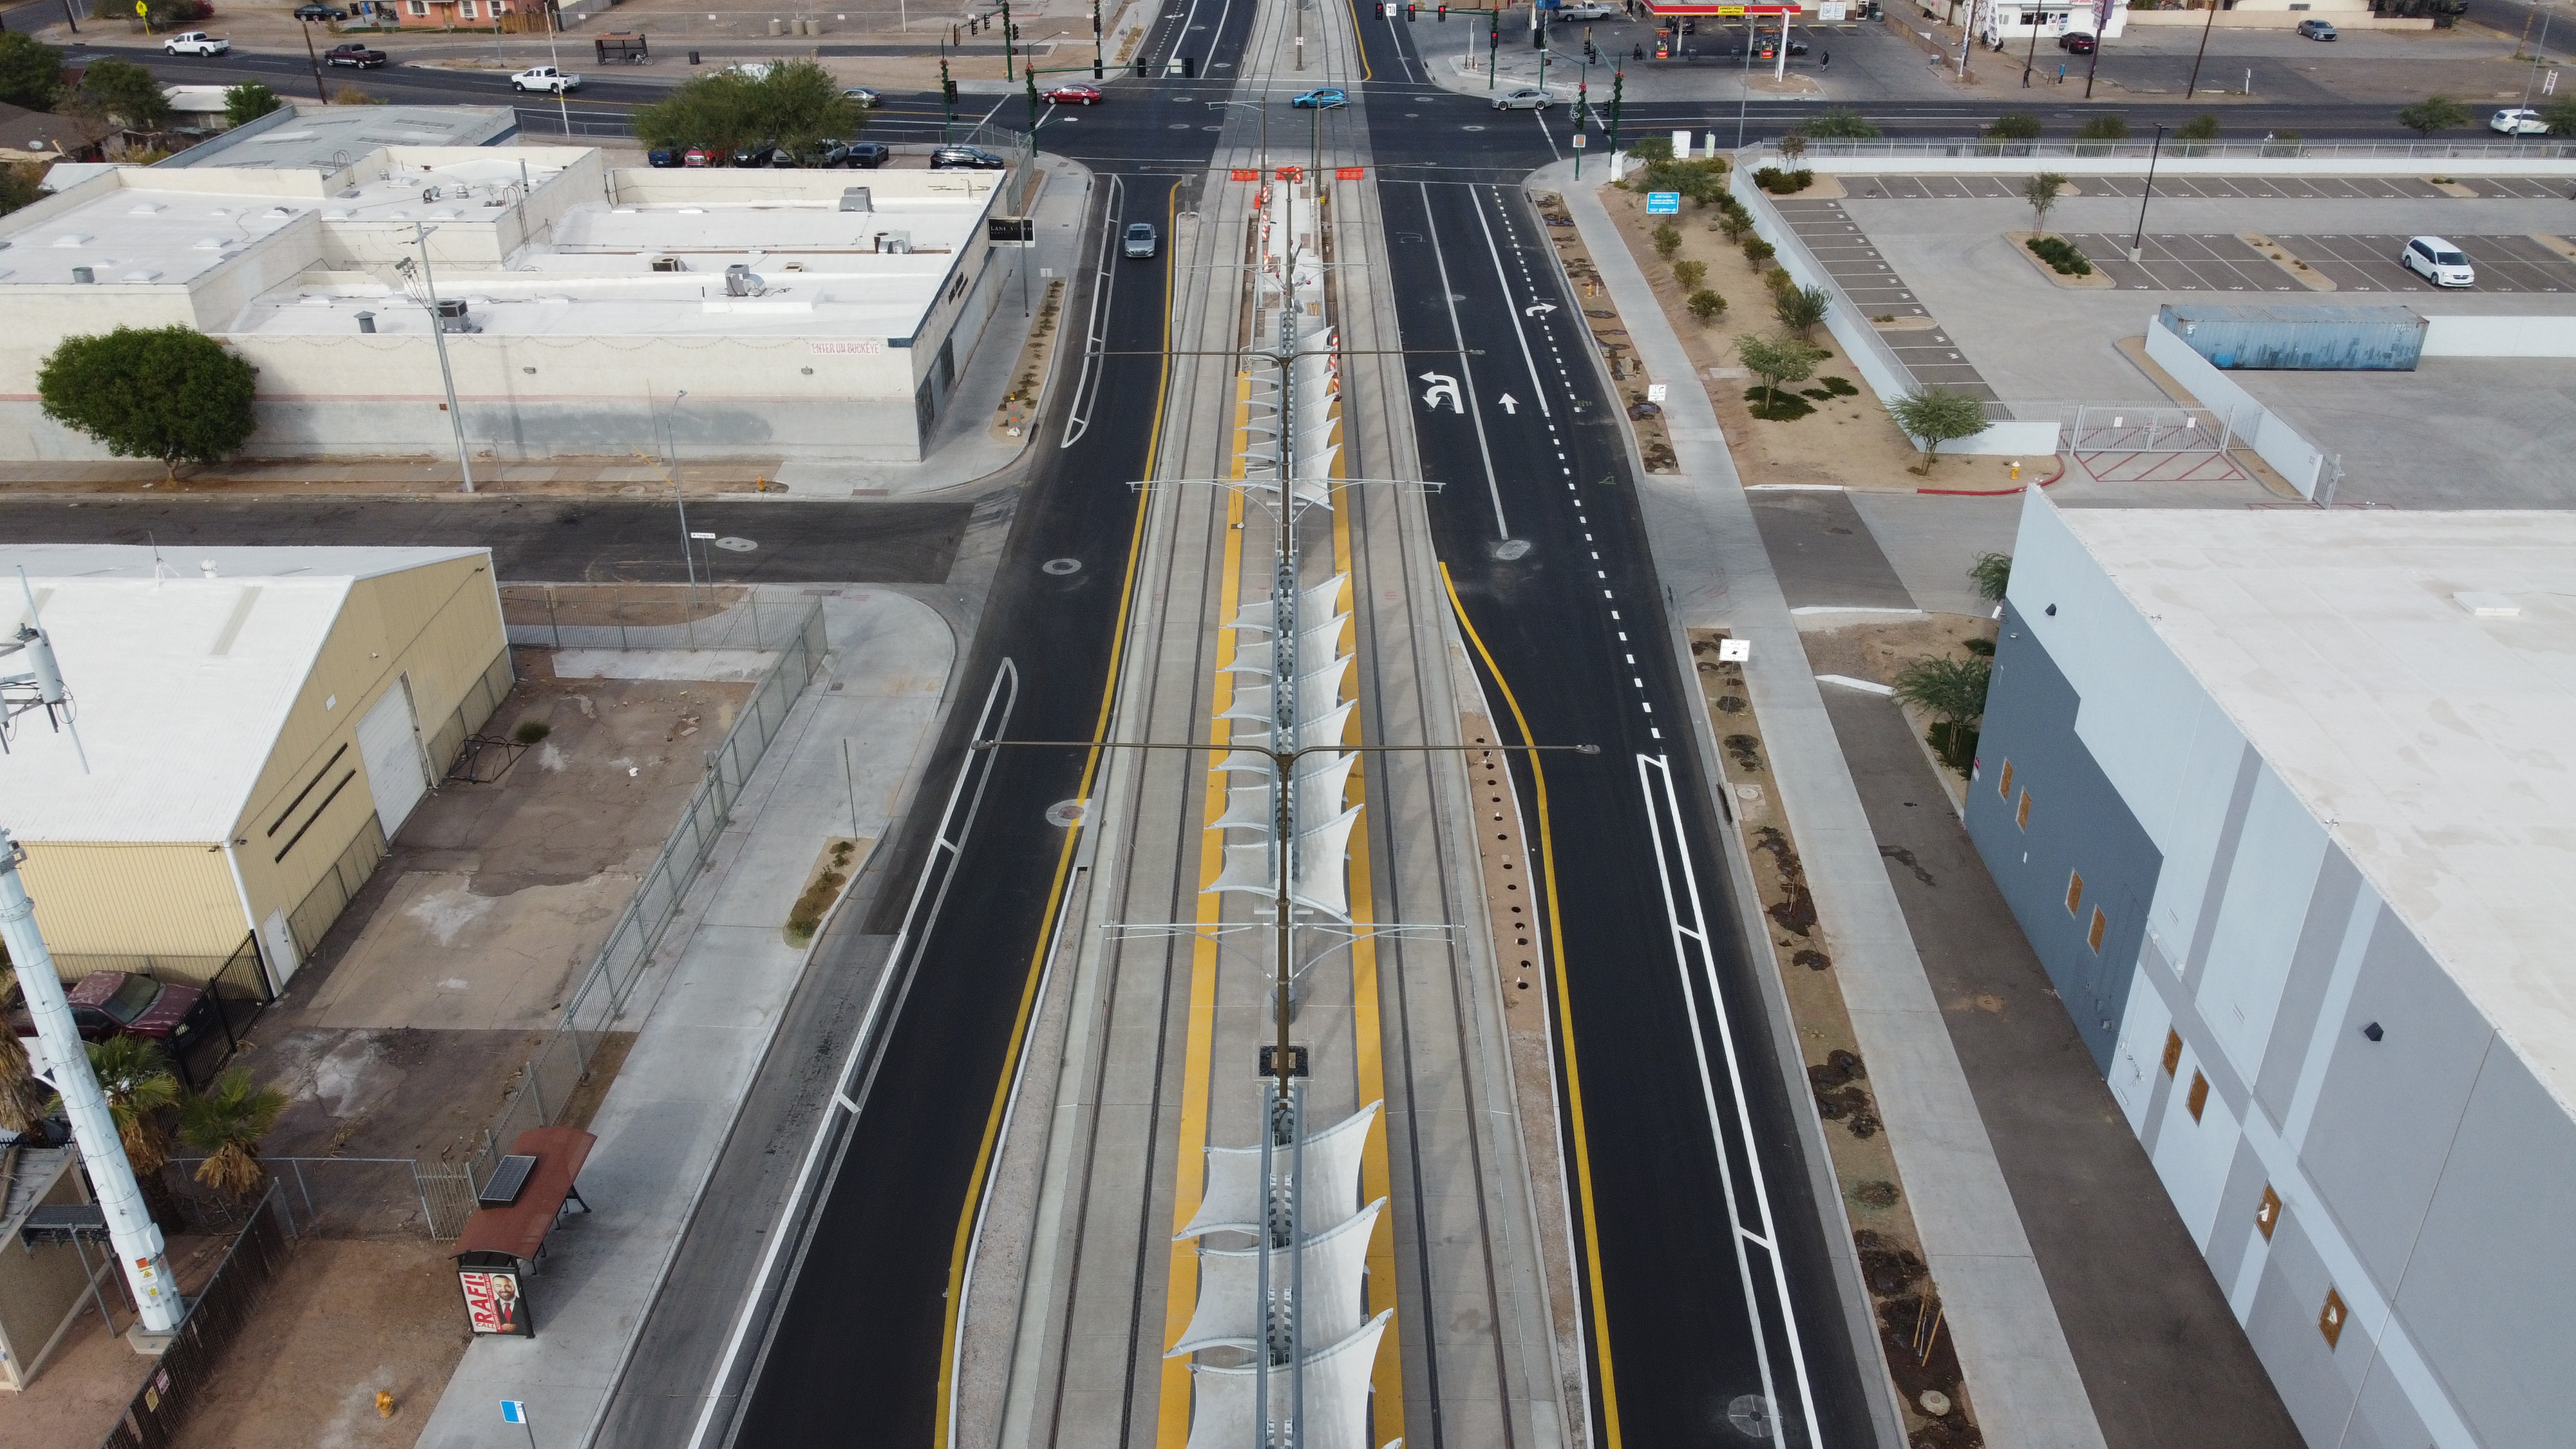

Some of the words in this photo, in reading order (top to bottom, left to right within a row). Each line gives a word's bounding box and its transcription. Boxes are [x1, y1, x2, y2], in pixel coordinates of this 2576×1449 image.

[812, 343, 835, 354] ENTER
[836, 343, 846, 353] ON
[848, 343, 879, 354] BUCKEYE
[464, 1274, 494, 1324] RAFI!
